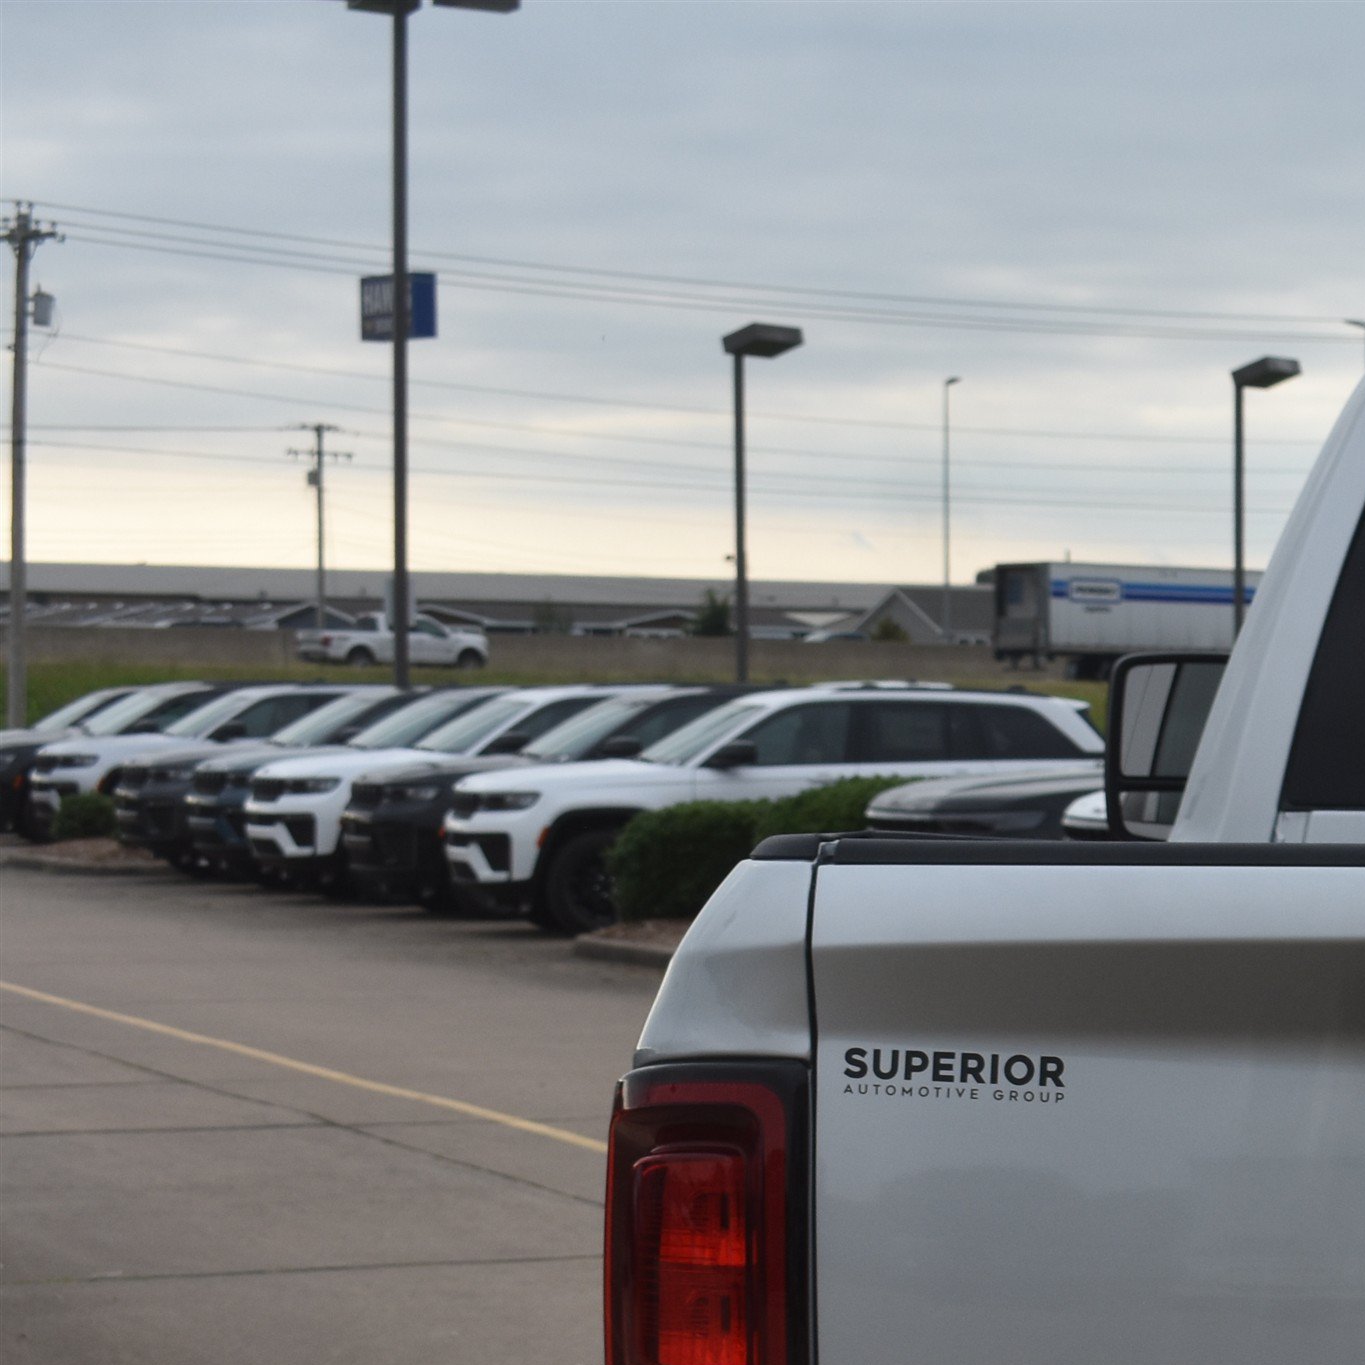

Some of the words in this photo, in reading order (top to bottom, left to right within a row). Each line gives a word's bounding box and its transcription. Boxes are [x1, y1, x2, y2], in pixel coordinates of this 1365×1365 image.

[843, 1047, 1066, 1088] SUPERIOR
[843, 1083, 980, 1100] AUTOMOTIVE
[993, 1089, 1066, 1103] GROUP
